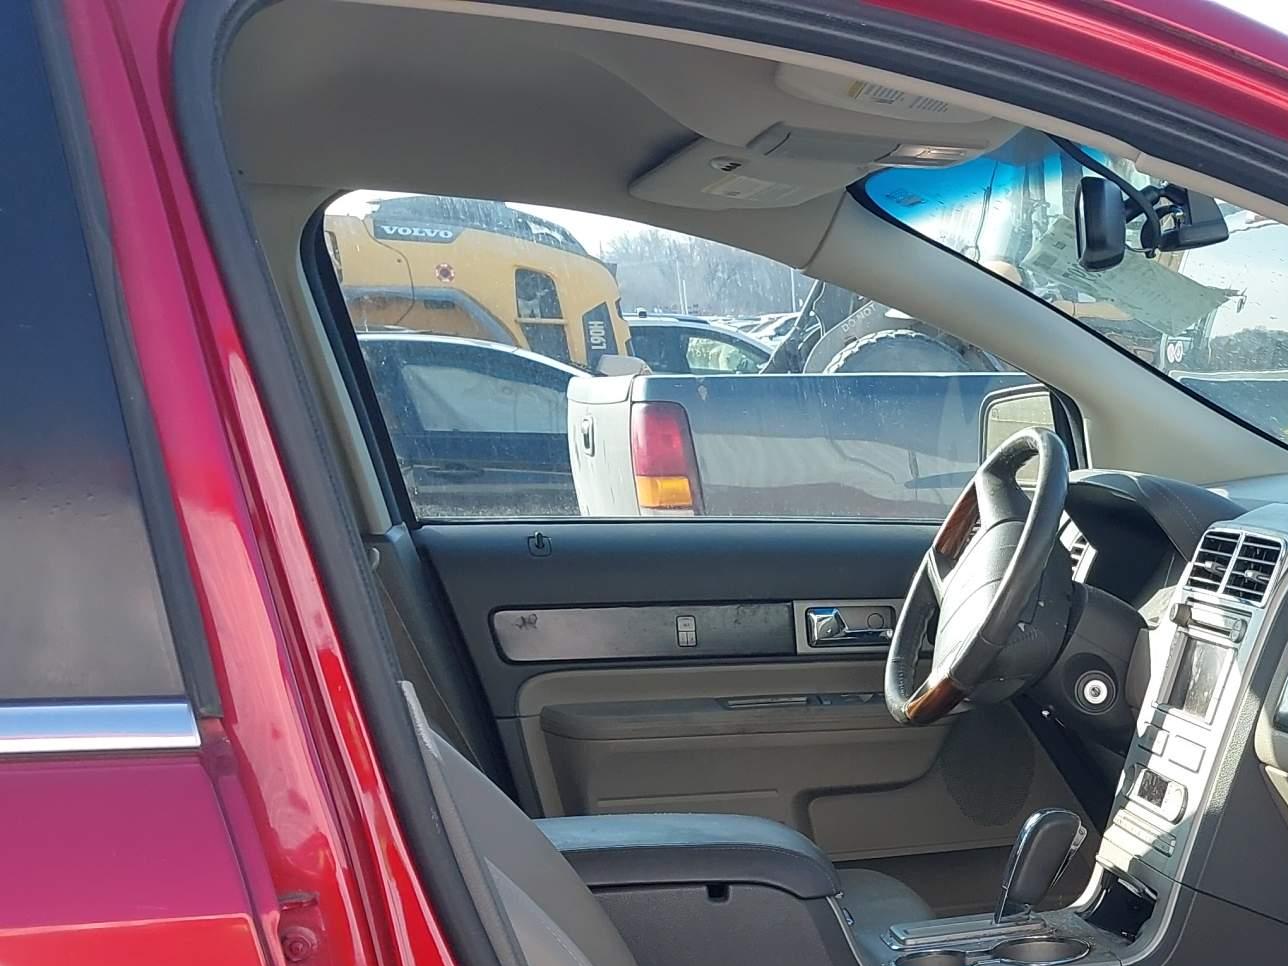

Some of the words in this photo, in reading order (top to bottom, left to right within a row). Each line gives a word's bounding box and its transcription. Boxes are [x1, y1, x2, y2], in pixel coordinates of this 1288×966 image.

[381, 225, 453, 238] VOLVO
[841, 318, 856, 332] DO
[857, 304, 877, 320] NOT
[588, 320, 607, 350] L90H
